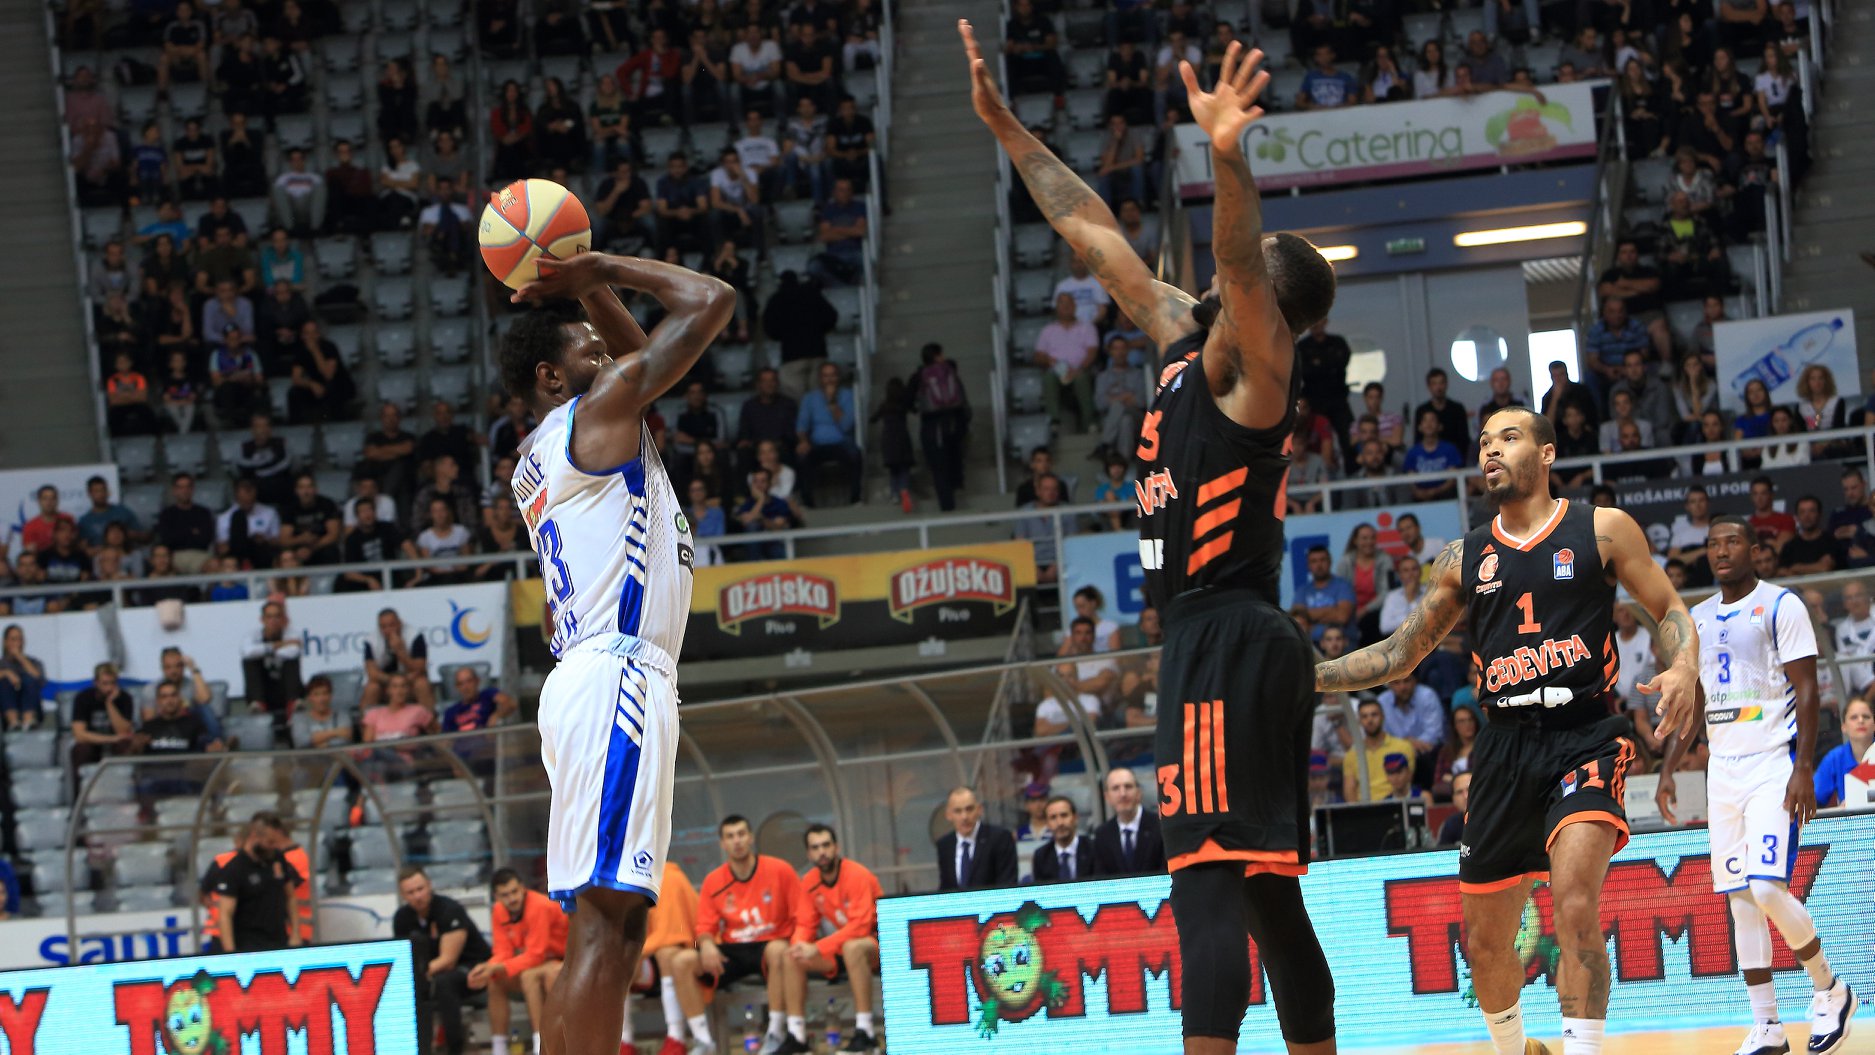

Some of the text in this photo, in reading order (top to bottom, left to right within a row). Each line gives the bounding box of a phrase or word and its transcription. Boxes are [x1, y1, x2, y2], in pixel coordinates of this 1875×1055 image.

[1297, 121, 1464, 171] Catering
[1556, 564, 1572, 577] ABA
[1516, 591, 1541, 634] 1
[1486, 634, 1591, 693] CEDEVITA
[1717, 652, 1731, 684] 3
[1580, 760, 1605, 789] 1
[1761, 834, 1778, 866] 3
